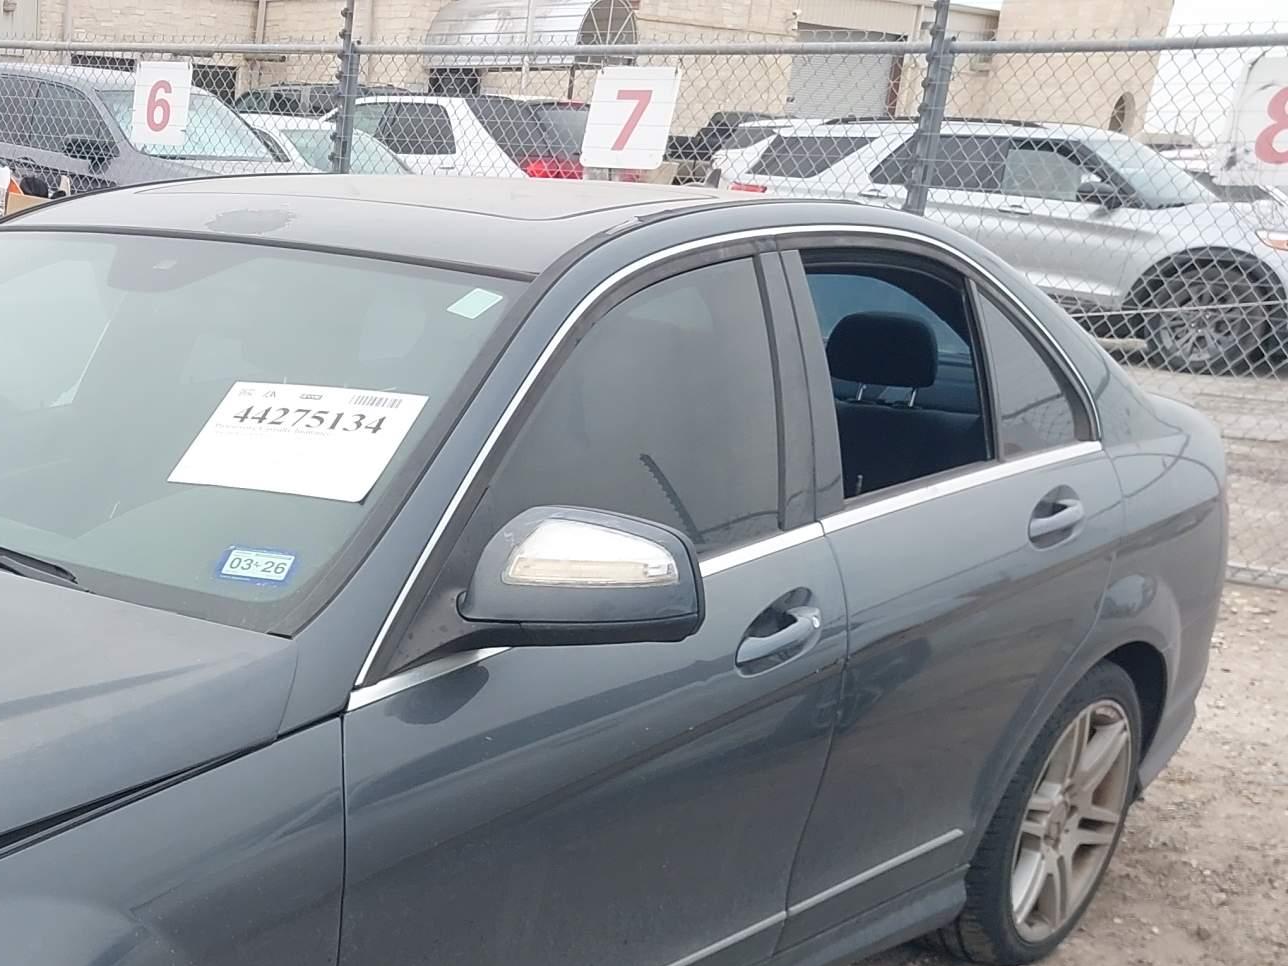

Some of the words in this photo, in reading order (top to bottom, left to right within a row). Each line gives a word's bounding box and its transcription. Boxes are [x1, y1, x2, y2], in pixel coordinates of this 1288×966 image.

[146, 80, 172, 132] 6
[610, 89, 652, 151] 7
[233, 405, 386, 434] 44275134
